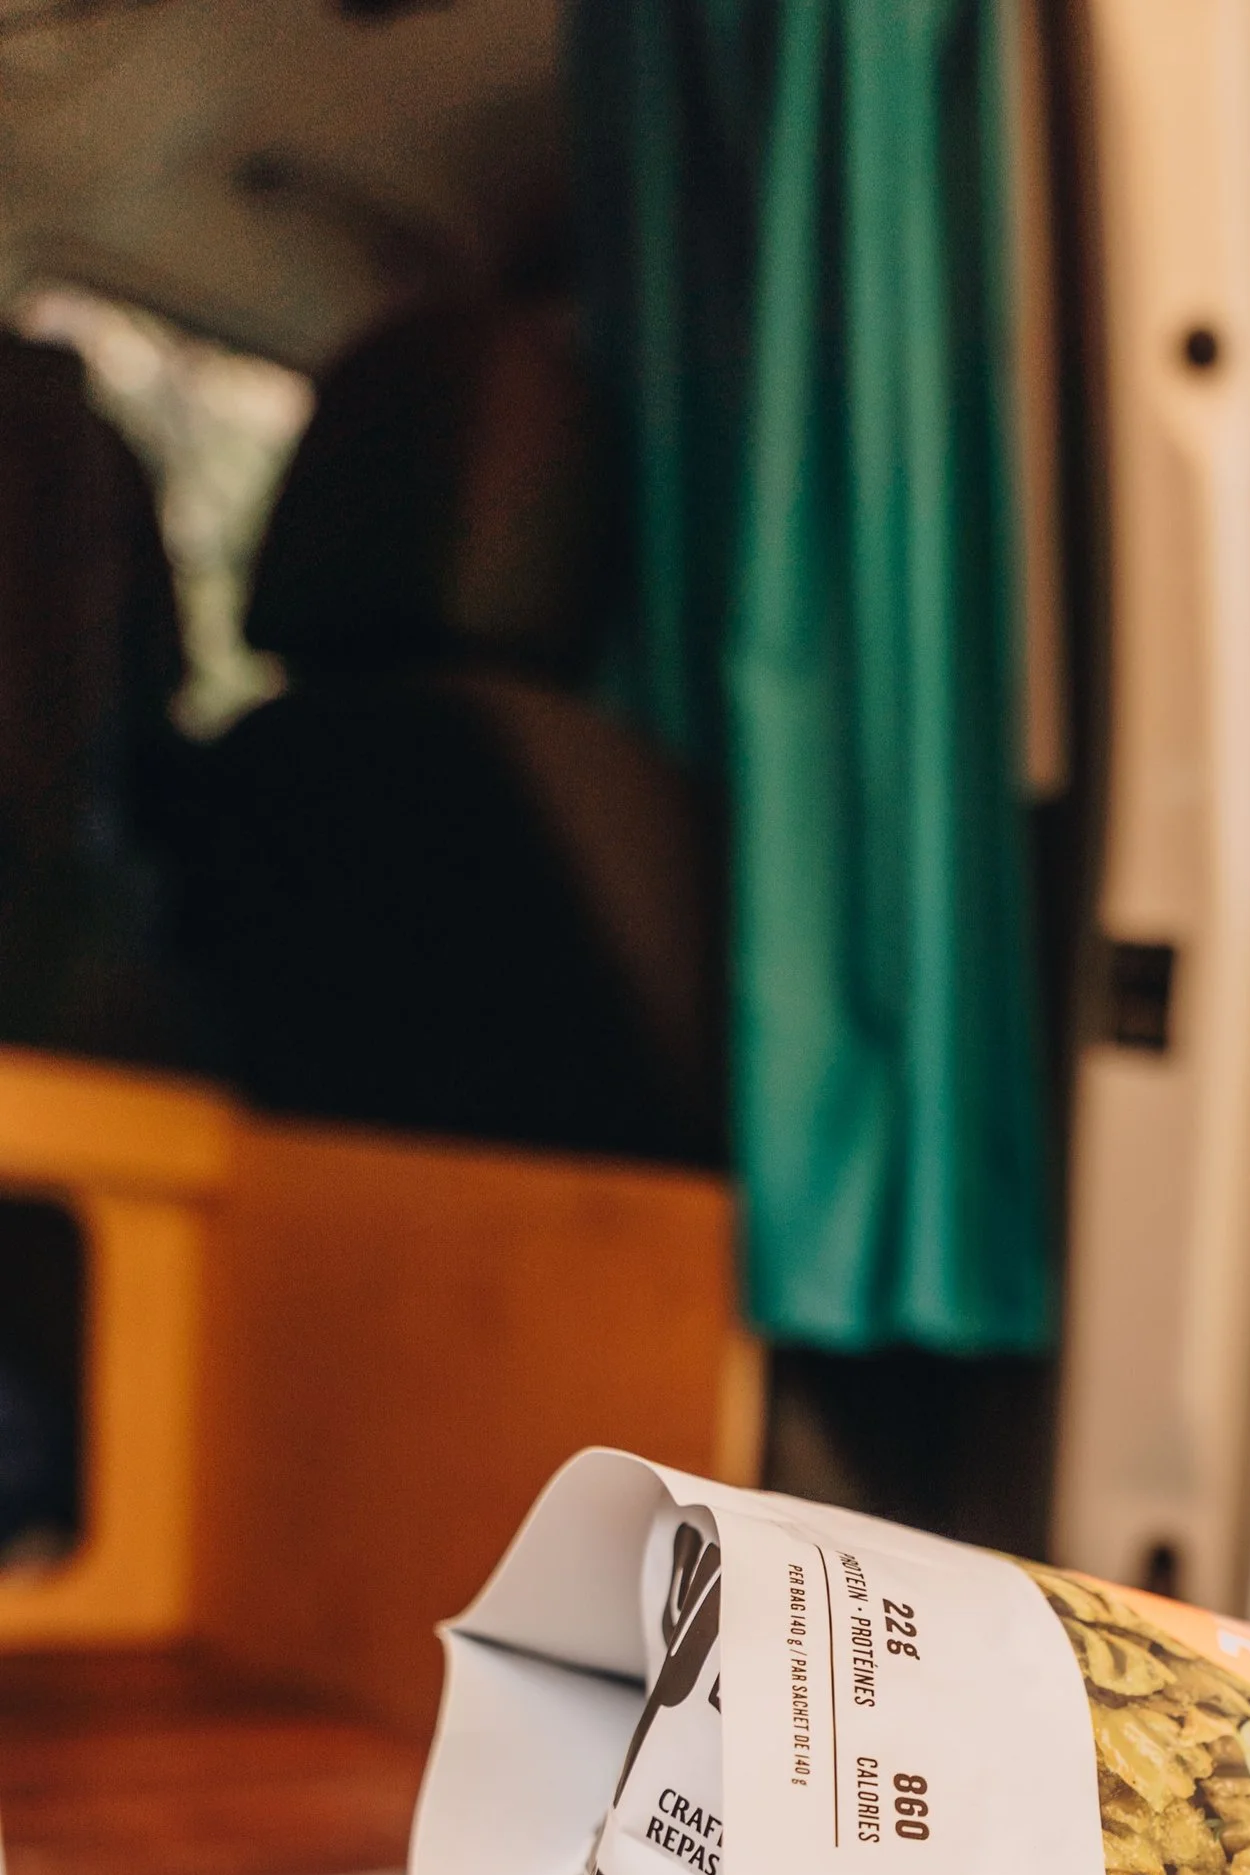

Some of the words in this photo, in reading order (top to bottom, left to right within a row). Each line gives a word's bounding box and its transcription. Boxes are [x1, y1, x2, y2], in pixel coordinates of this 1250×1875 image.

[788, 1564, 804, 1585] PER
[789, 1587, 806, 1611] BAG
[790, 1615, 806, 1636] 140
[790, 1658, 807, 1681] PAR
[850, 1616, 879, 1708] PROTÉINES
[791, 1684, 809, 1731] SACHET
[794, 1734, 810, 1751] DE
[794, 1754, 811, 1775] 140
[856, 1756, 880, 1844] CALORIES
[892, 1773, 930, 1841] 860
[658, 1788, 723, 1848] CRAF
